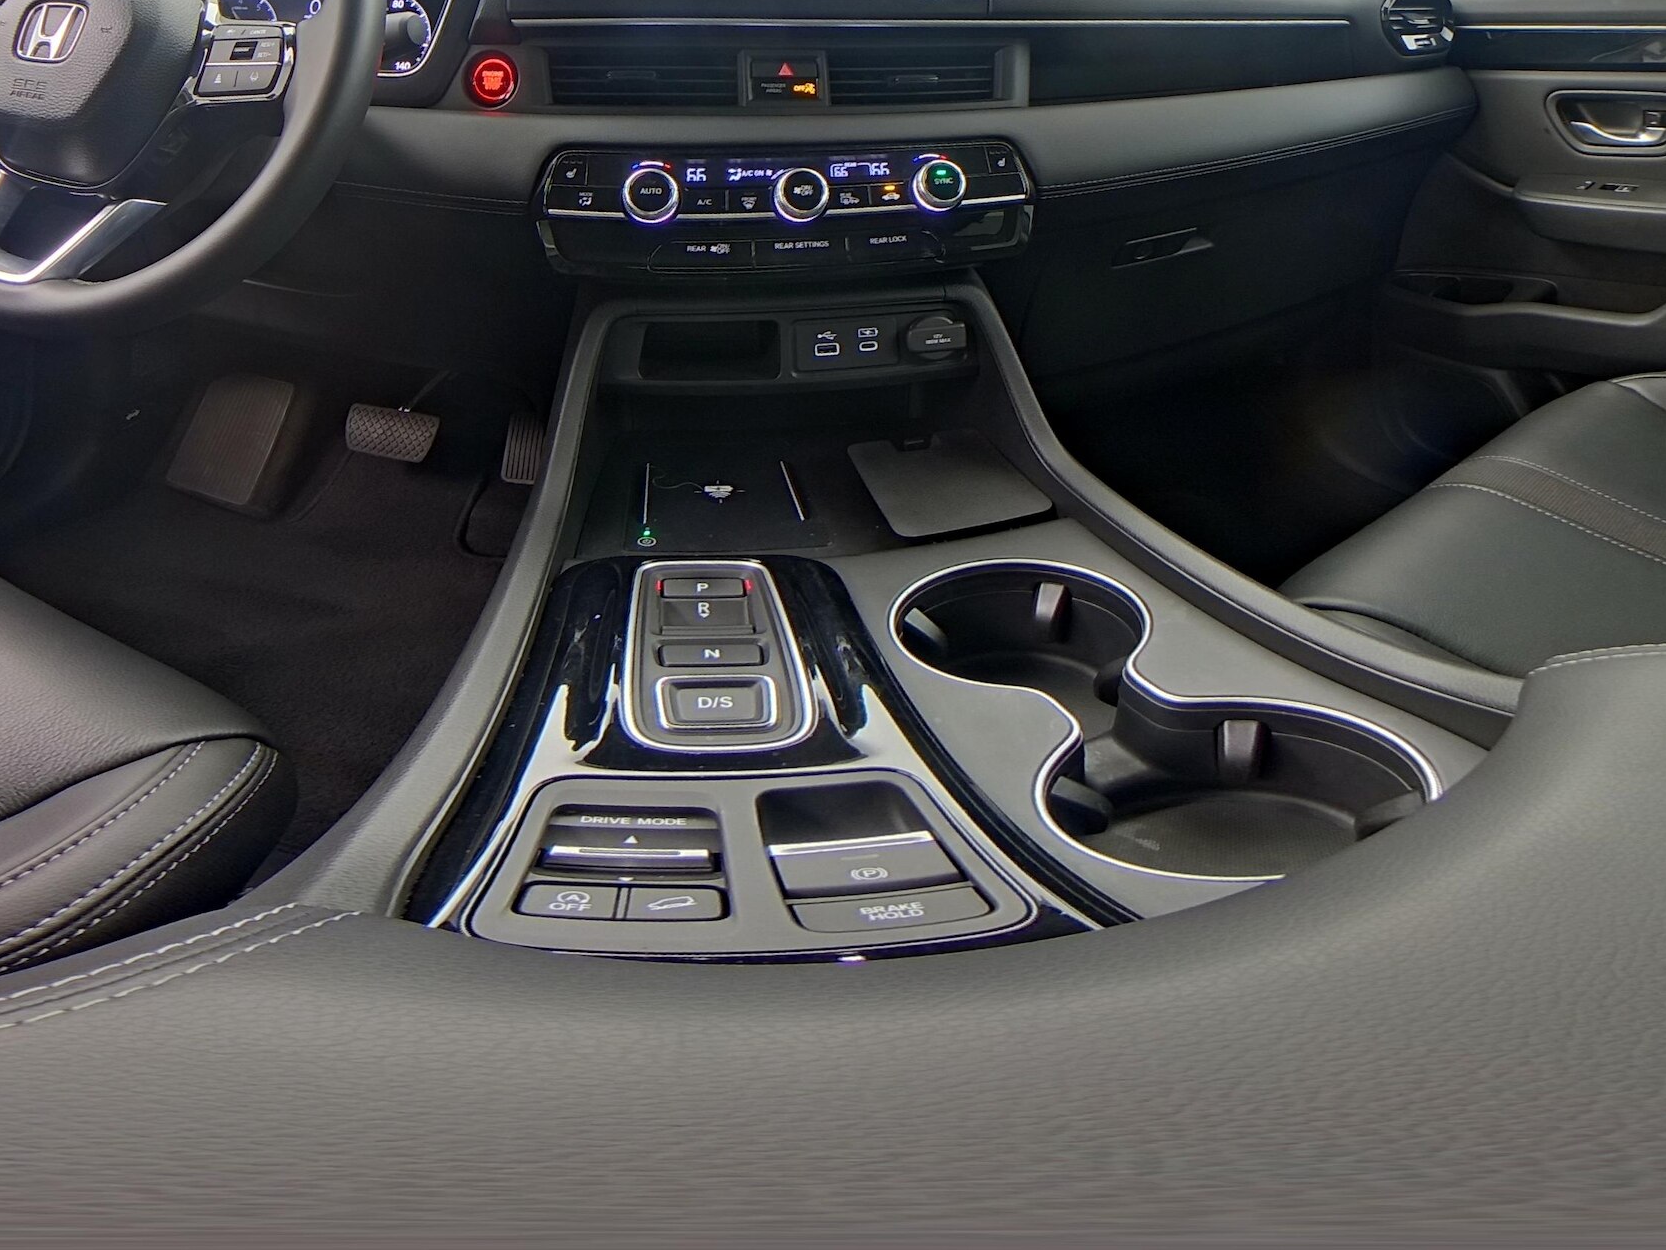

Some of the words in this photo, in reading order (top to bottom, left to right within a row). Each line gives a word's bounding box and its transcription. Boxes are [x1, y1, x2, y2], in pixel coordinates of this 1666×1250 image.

[310, 0, 321, 14] 0
[395, 62, 411, 70] 140
[934, 177, 954, 185] SYNC
[640, 187, 662, 195] AUTO
[795, 240, 829, 248] SETTINGS
[889, 235, 907, 243] LOCK
[697, 582, 709, 592] P
[697, 602, 710, 614] R
[704, 649, 721, 658] N
[697, 696, 733, 708] D/S
[580, 816, 631, 825] DRIVE
[637, 818, 687, 826] MODE
[549, 902, 592, 912] OFF
[859, 902, 925, 914] BRAKE
[869, 910, 925, 920] HOLD
